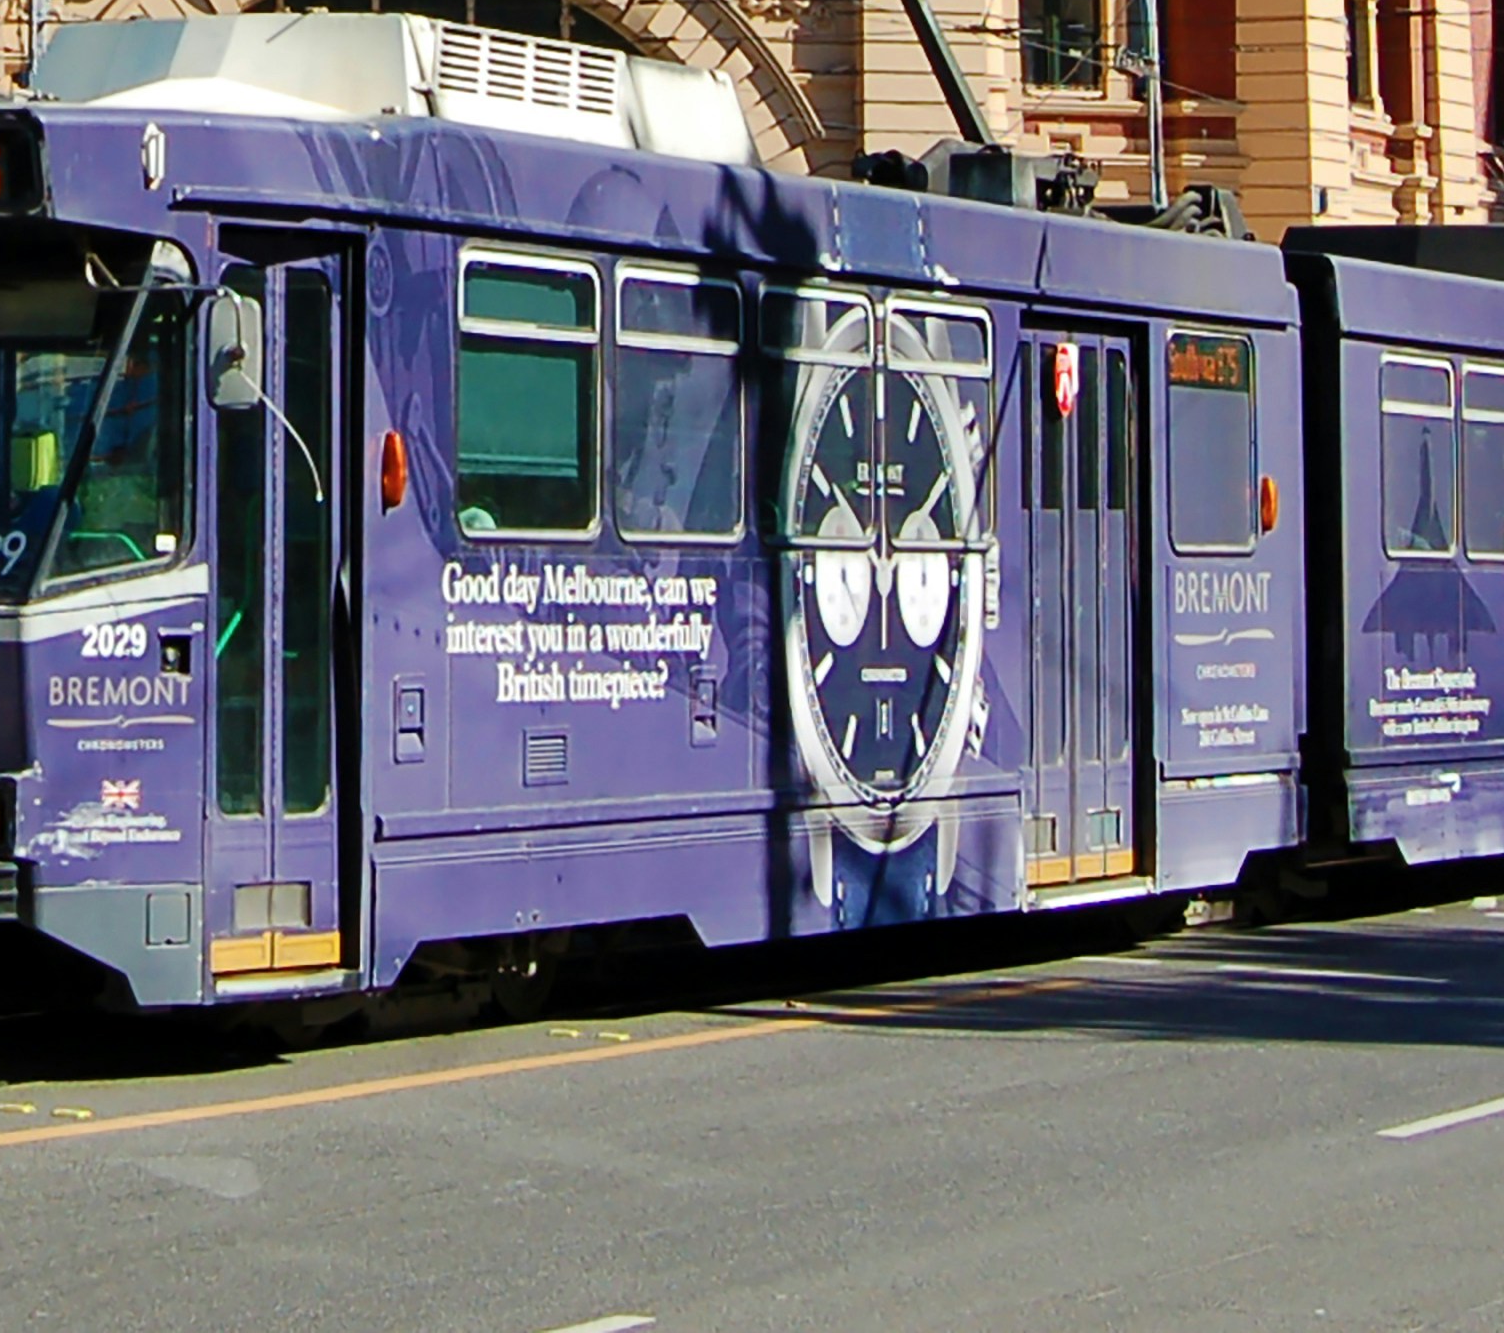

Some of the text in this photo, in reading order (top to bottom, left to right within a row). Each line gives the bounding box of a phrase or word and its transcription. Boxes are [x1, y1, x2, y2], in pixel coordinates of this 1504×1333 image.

[442, 562, 717, 614] Good day Melbourne, can we
[1174, 571, 1271, 613] BREMONT
[81, 623, 147, 657] 2029
[446, 612, 714, 662] interest you in a wonderfully
[49, 675, 192, 707] BREMONT
[496, 660, 669, 709] British timepiece?
